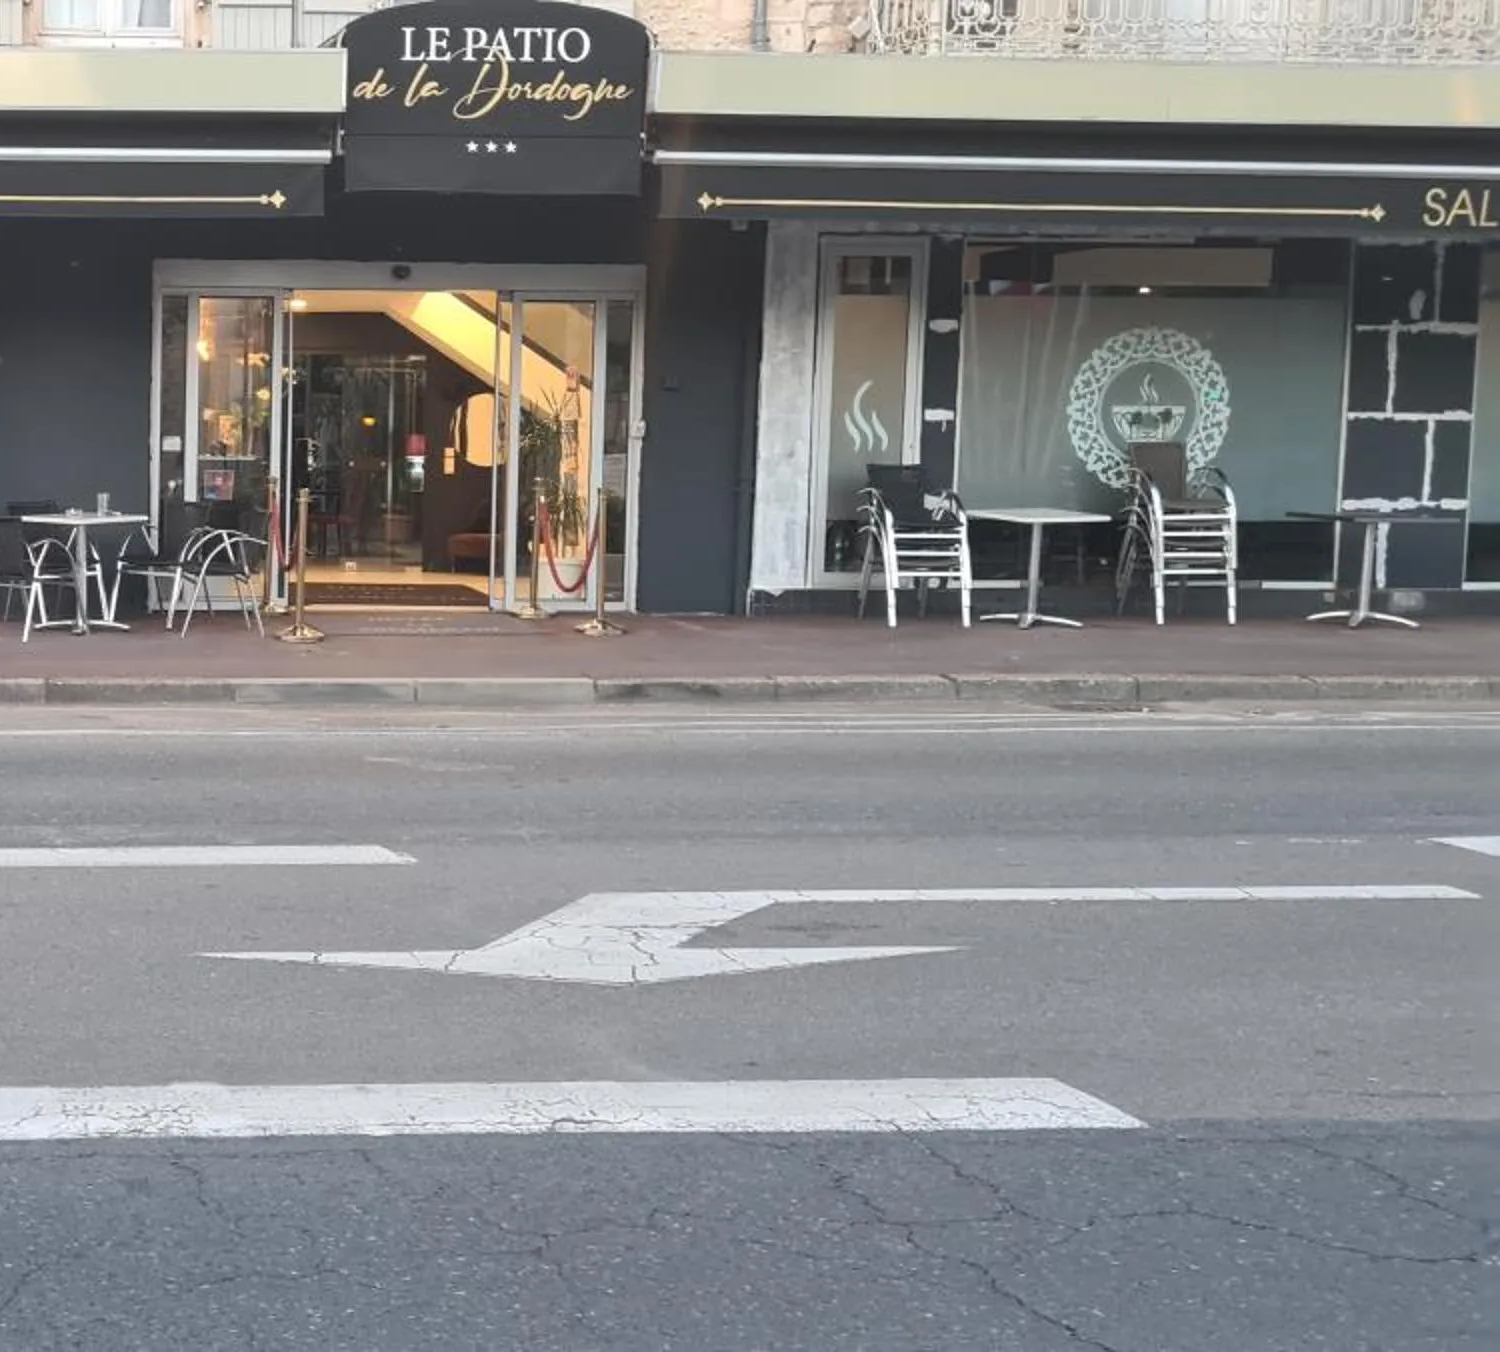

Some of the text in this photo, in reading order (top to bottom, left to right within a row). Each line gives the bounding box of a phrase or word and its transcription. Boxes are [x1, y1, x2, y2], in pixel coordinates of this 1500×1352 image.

[401, 27, 591, 62] LE PATIO
[352, 45, 633, 120] de la Dordogne
[1422, 187, 1498, 227] SAL
